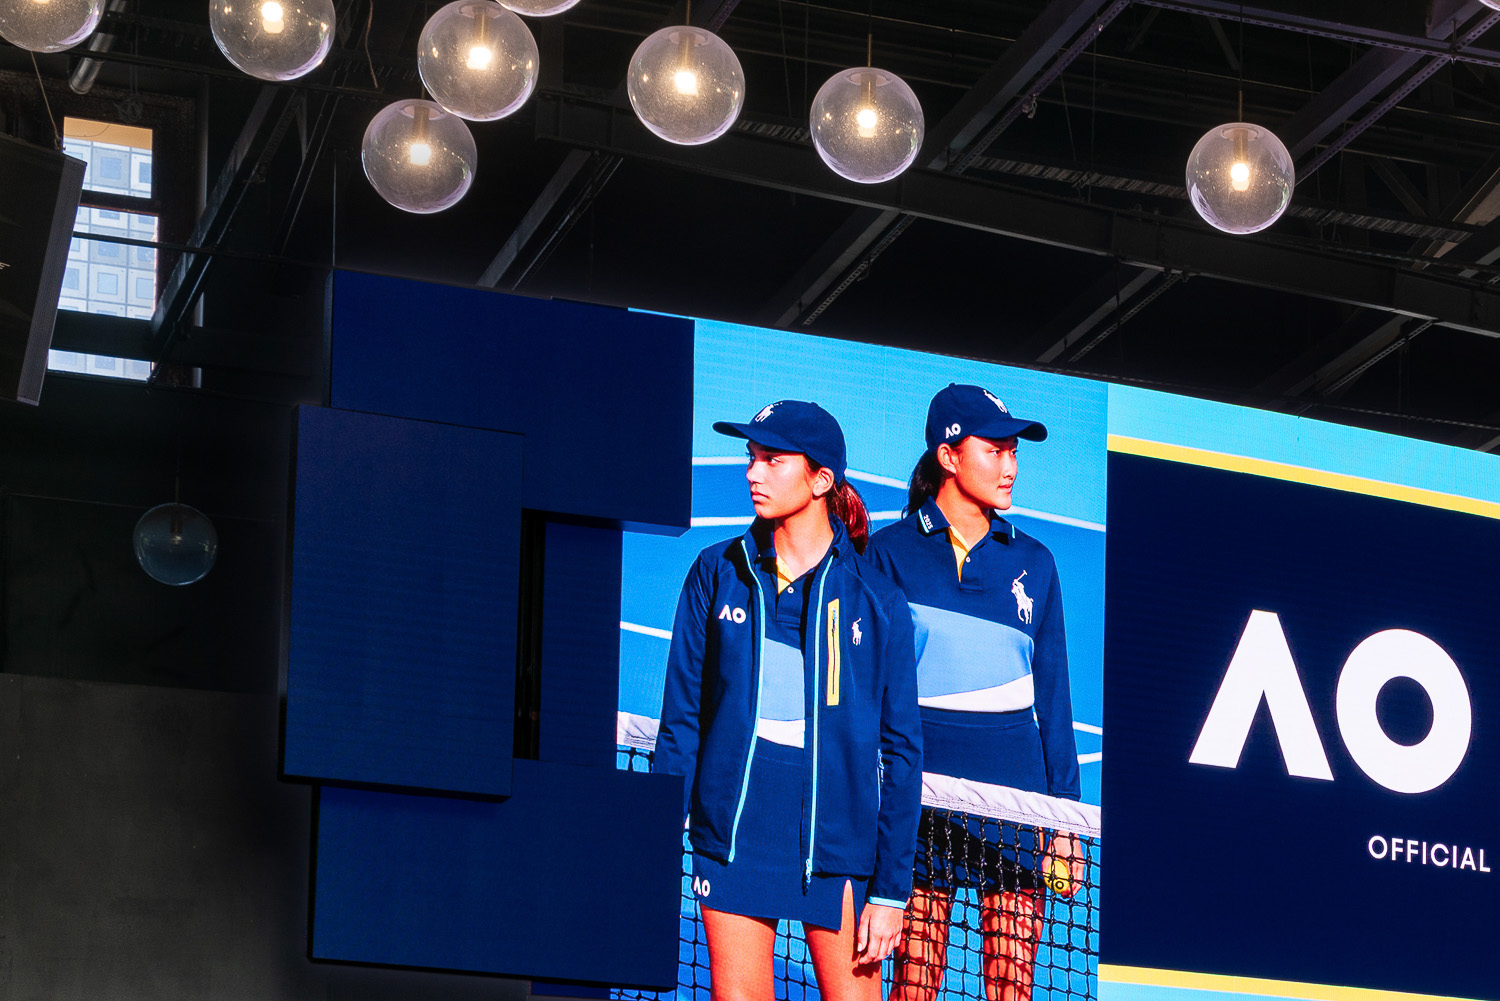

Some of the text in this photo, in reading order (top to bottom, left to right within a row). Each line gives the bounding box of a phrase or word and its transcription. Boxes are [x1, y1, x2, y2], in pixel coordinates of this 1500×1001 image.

[945, 423, 961, 439] AO
[719, 604, 746, 624] AO
[1188, 609, 1472, 794] AO
[1368, 835, 1491, 873] OFFICIAL
[693, 875, 711, 897] AO
